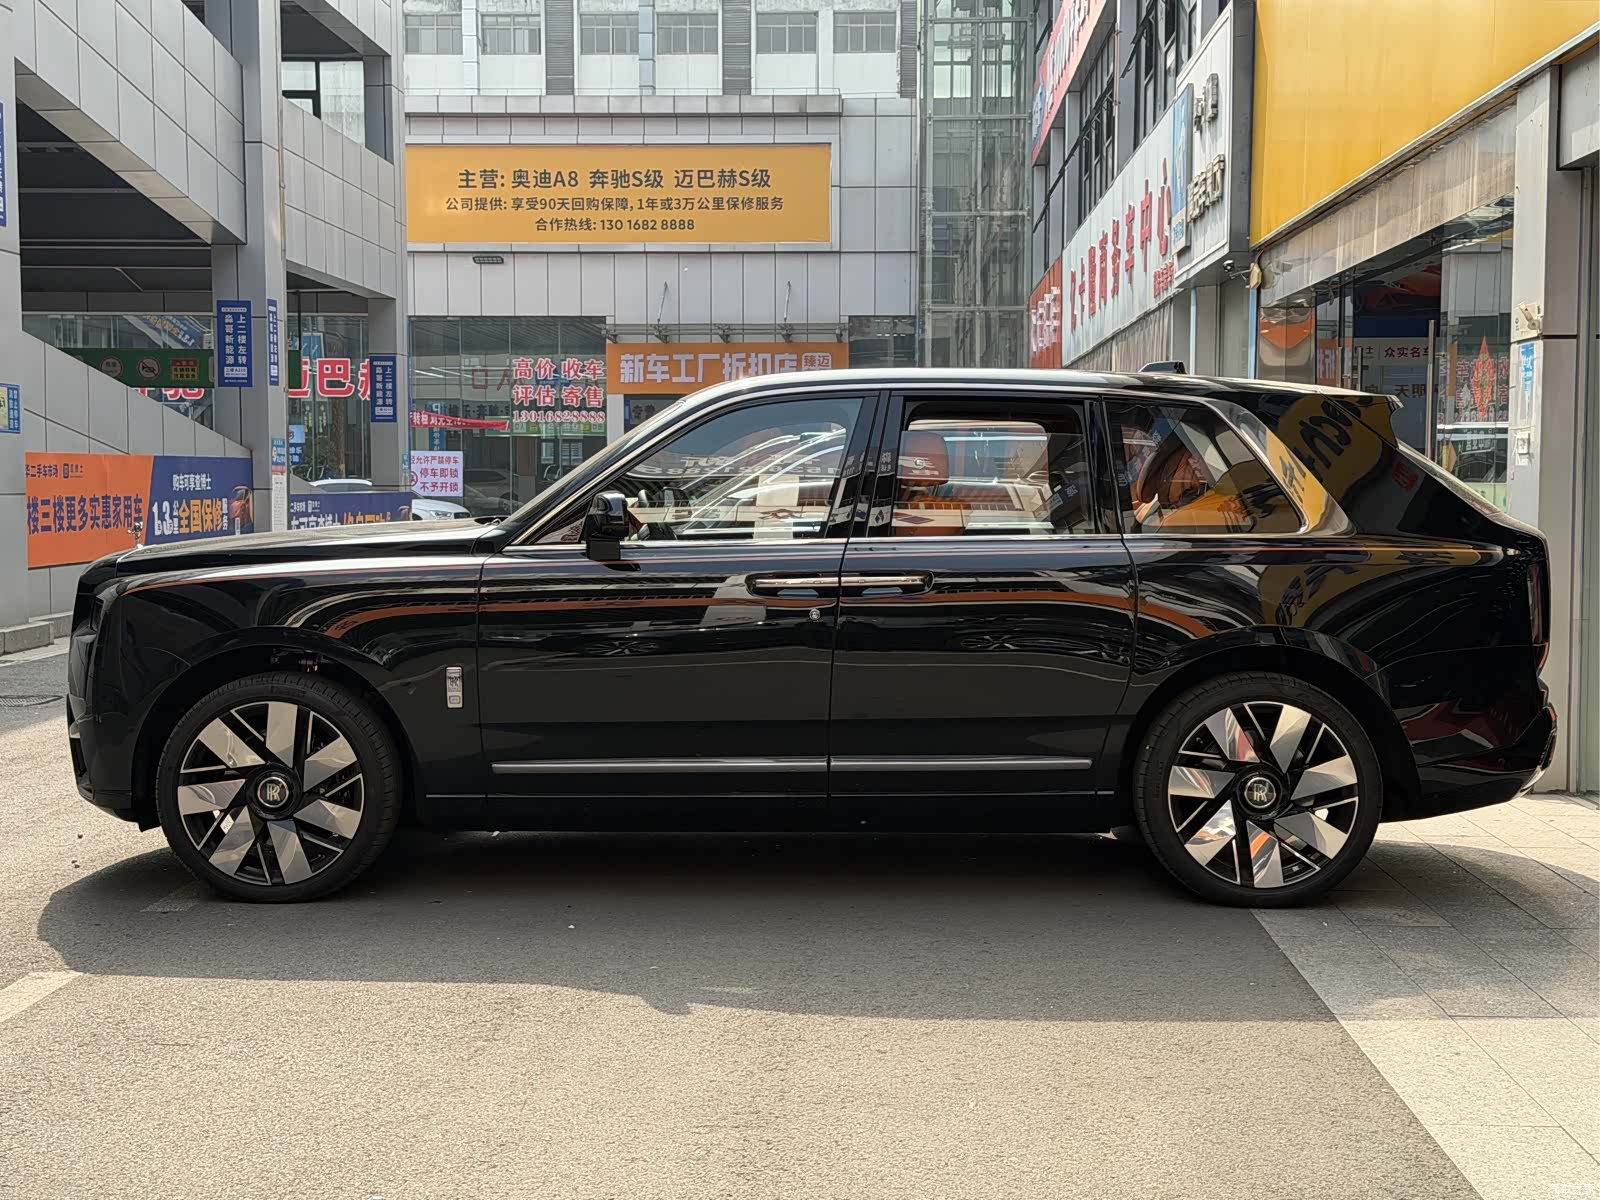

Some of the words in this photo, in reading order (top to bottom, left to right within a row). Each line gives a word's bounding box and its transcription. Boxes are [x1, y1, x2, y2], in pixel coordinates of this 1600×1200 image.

[589, 169, 664, 189] 奔驰S级
[674, 169, 771, 189] 迈巴赫S级
[627, 220, 658, 231] 1682
[660, 220, 695, 231] 8888
[237, 314, 247, 364] 上二楼左转
[513, 358, 556, 379] 高价
[561, 358, 604, 380] 收车
[620, 352, 798, 383] 新车工厂折扣店
[803, 354, 831, 368] 臻迈
[513, 385, 556, 406] 评估
[562, 385, 605, 407] 寄售
[513, 410, 606, 423] 13016828888
[420, 468, 459, 478] 停车即锁
[420, 482, 459, 492] 不予开锁
